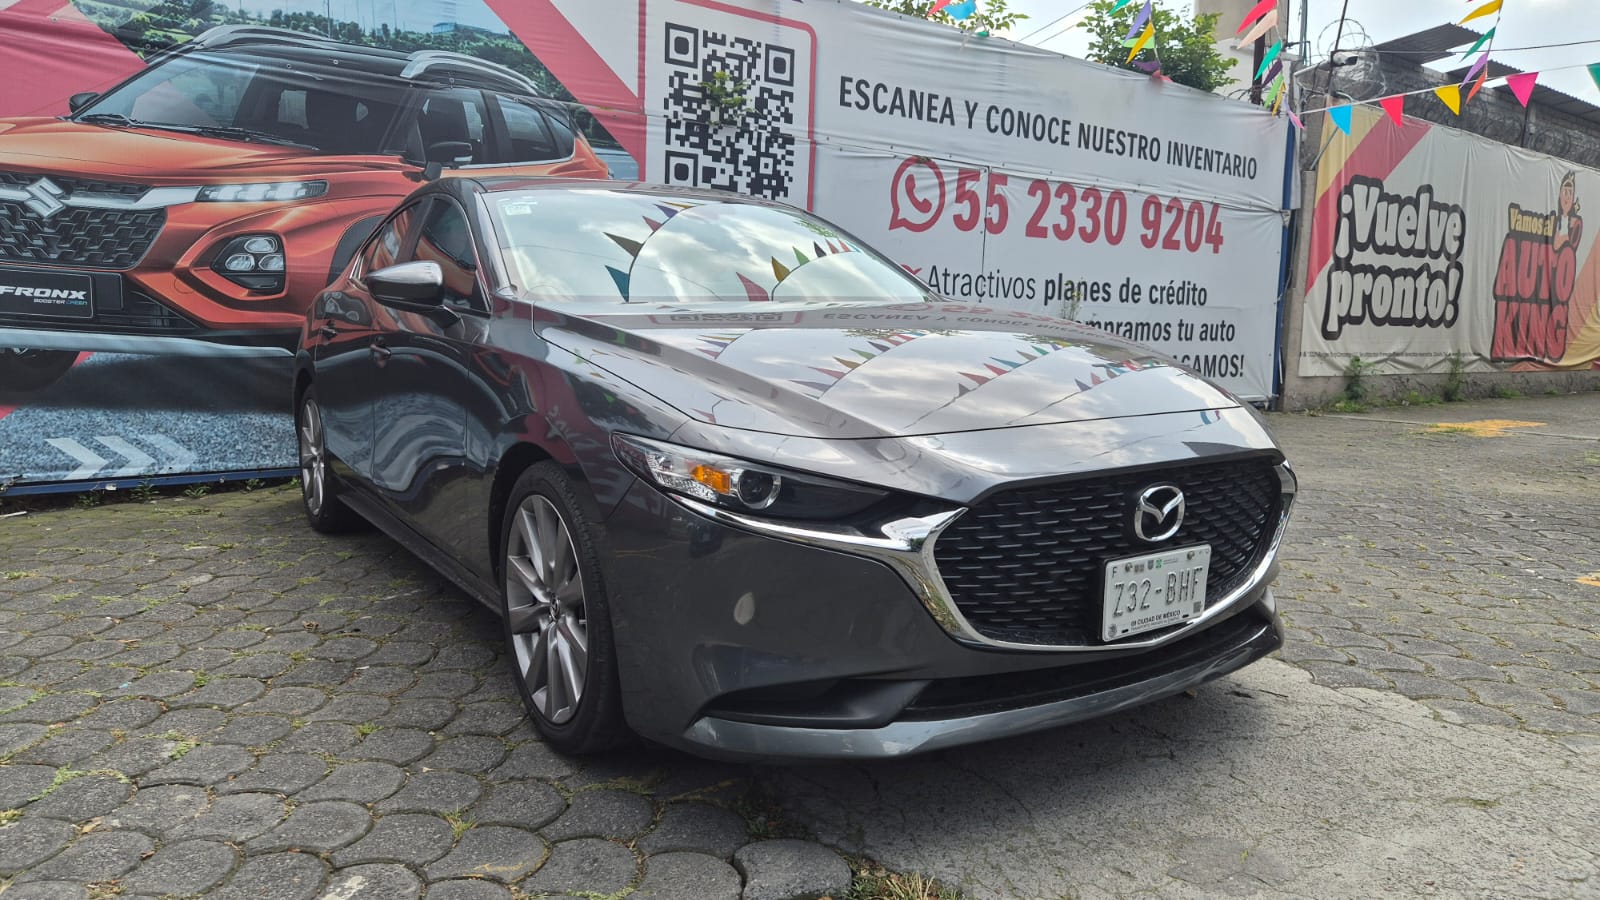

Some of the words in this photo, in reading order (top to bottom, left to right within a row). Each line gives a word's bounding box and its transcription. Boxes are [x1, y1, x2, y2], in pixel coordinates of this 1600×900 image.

[840, 76, 955, 126] ESCANEA
[964, 100, 979, 129] Y
[986, 105, 1071, 146] CONOCE
[1078, 123, 1161, 162] NUESTRO
[1167, 140, 1257, 180] INVENTARIO
[952, 168, 1008, 235] 55
[1025, 179, 1127, 246] 2330
[1140, 194, 1224, 254] 9204
[1334, 183, 1463, 258] ¡Vuelve
[1510, 207, 1543, 235] Vamos
[1543, 214, 1555, 237] al
[0, 285, 87, 299] FRONX
[928, 265, 1036, 299] Atractivos
[1044, 273, 1111, 305] planes
[1119, 277, 1141, 303] de
[1149, 278, 1207, 306] crédito
[1495, 238, 1576, 302] AUTO
[1327, 267, 1460, 332] pronto!
[1075, 320, 1171, 342] ramos
[1177, 319, 1193, 342] tu
[1200, 320, 1235, 342] auto
[1492, 302, 1567, 359] KING
[1173, 354, 1245, 378] AMOS!
[1113, 566, 1203, 617] Z32-BHF
